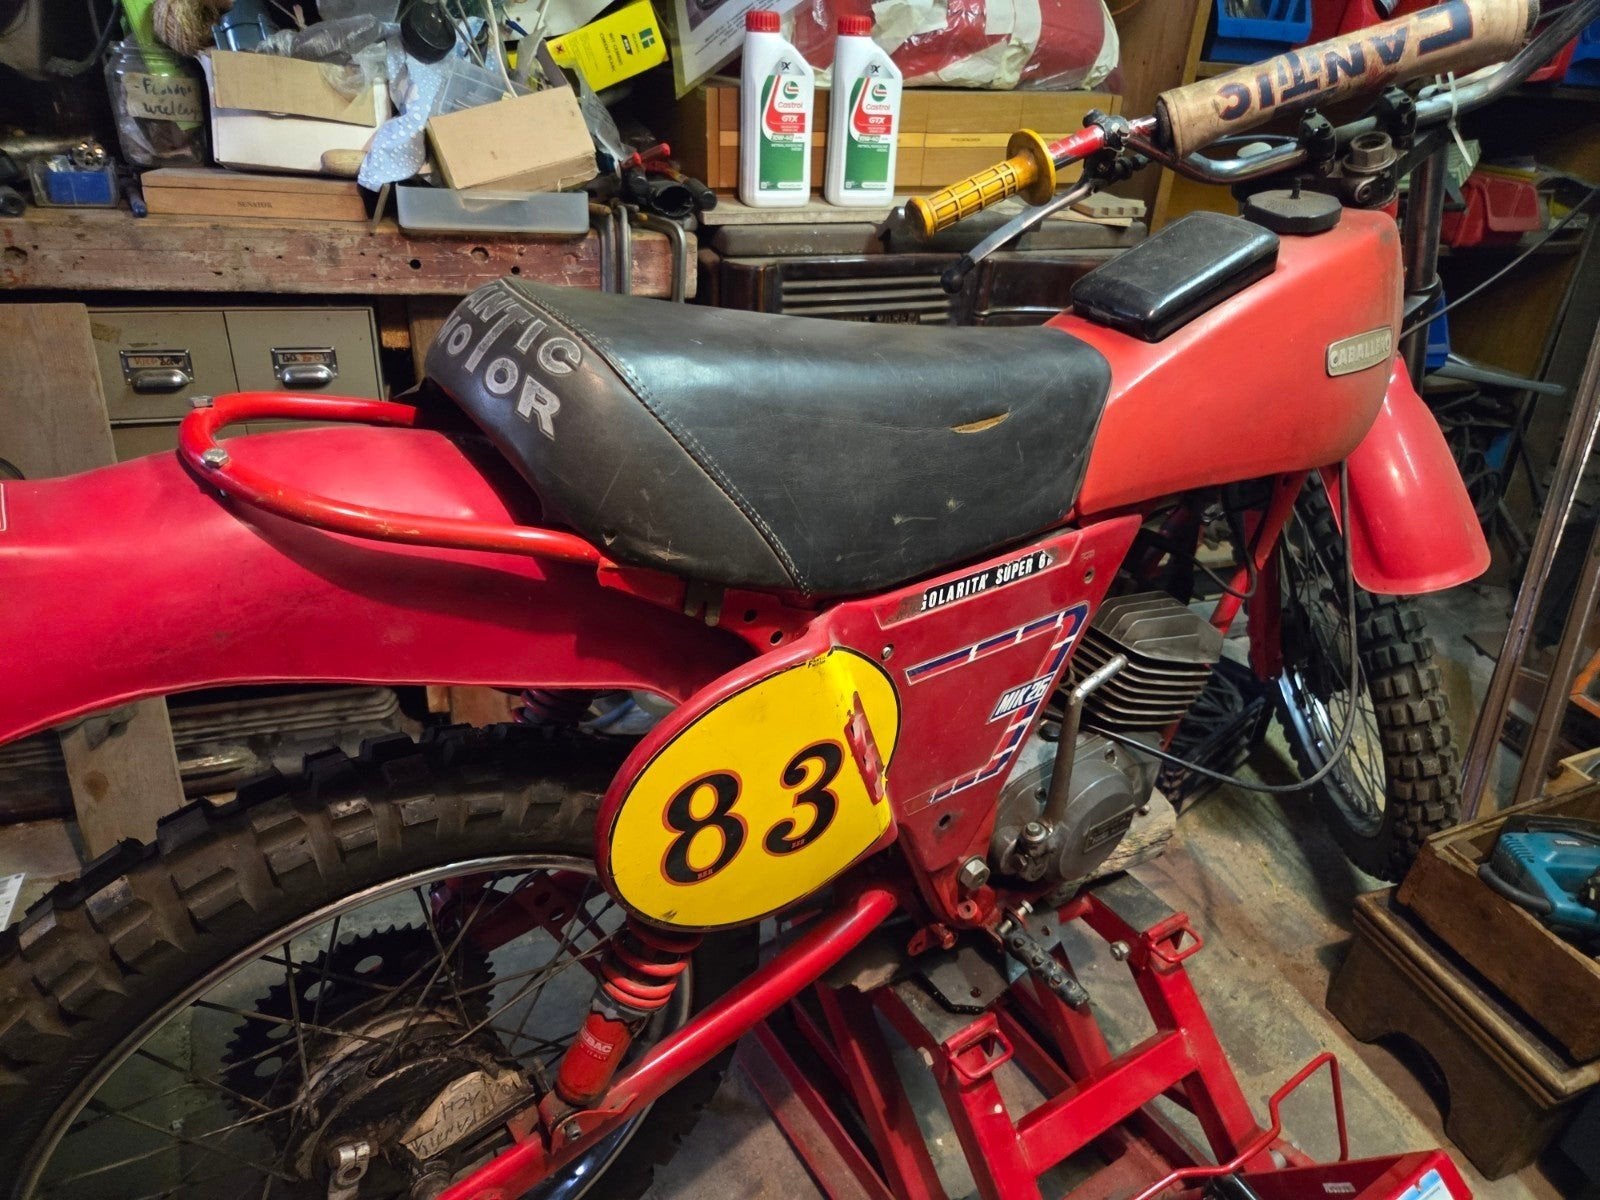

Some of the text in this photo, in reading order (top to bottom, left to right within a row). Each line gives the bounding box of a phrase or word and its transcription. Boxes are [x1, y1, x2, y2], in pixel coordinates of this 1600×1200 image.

[777, 101, 803, 109] Castrol
[865, 103, 891, 111] Castrol
[781, 115, 799, 123] GTX
[868, 116, 886, 125] GTX
[1329, 332, 1392, 368] CABALLERO
[995, 557, 1034, 585] SUPER
[581, 1029, 613, 1053] EBAC
